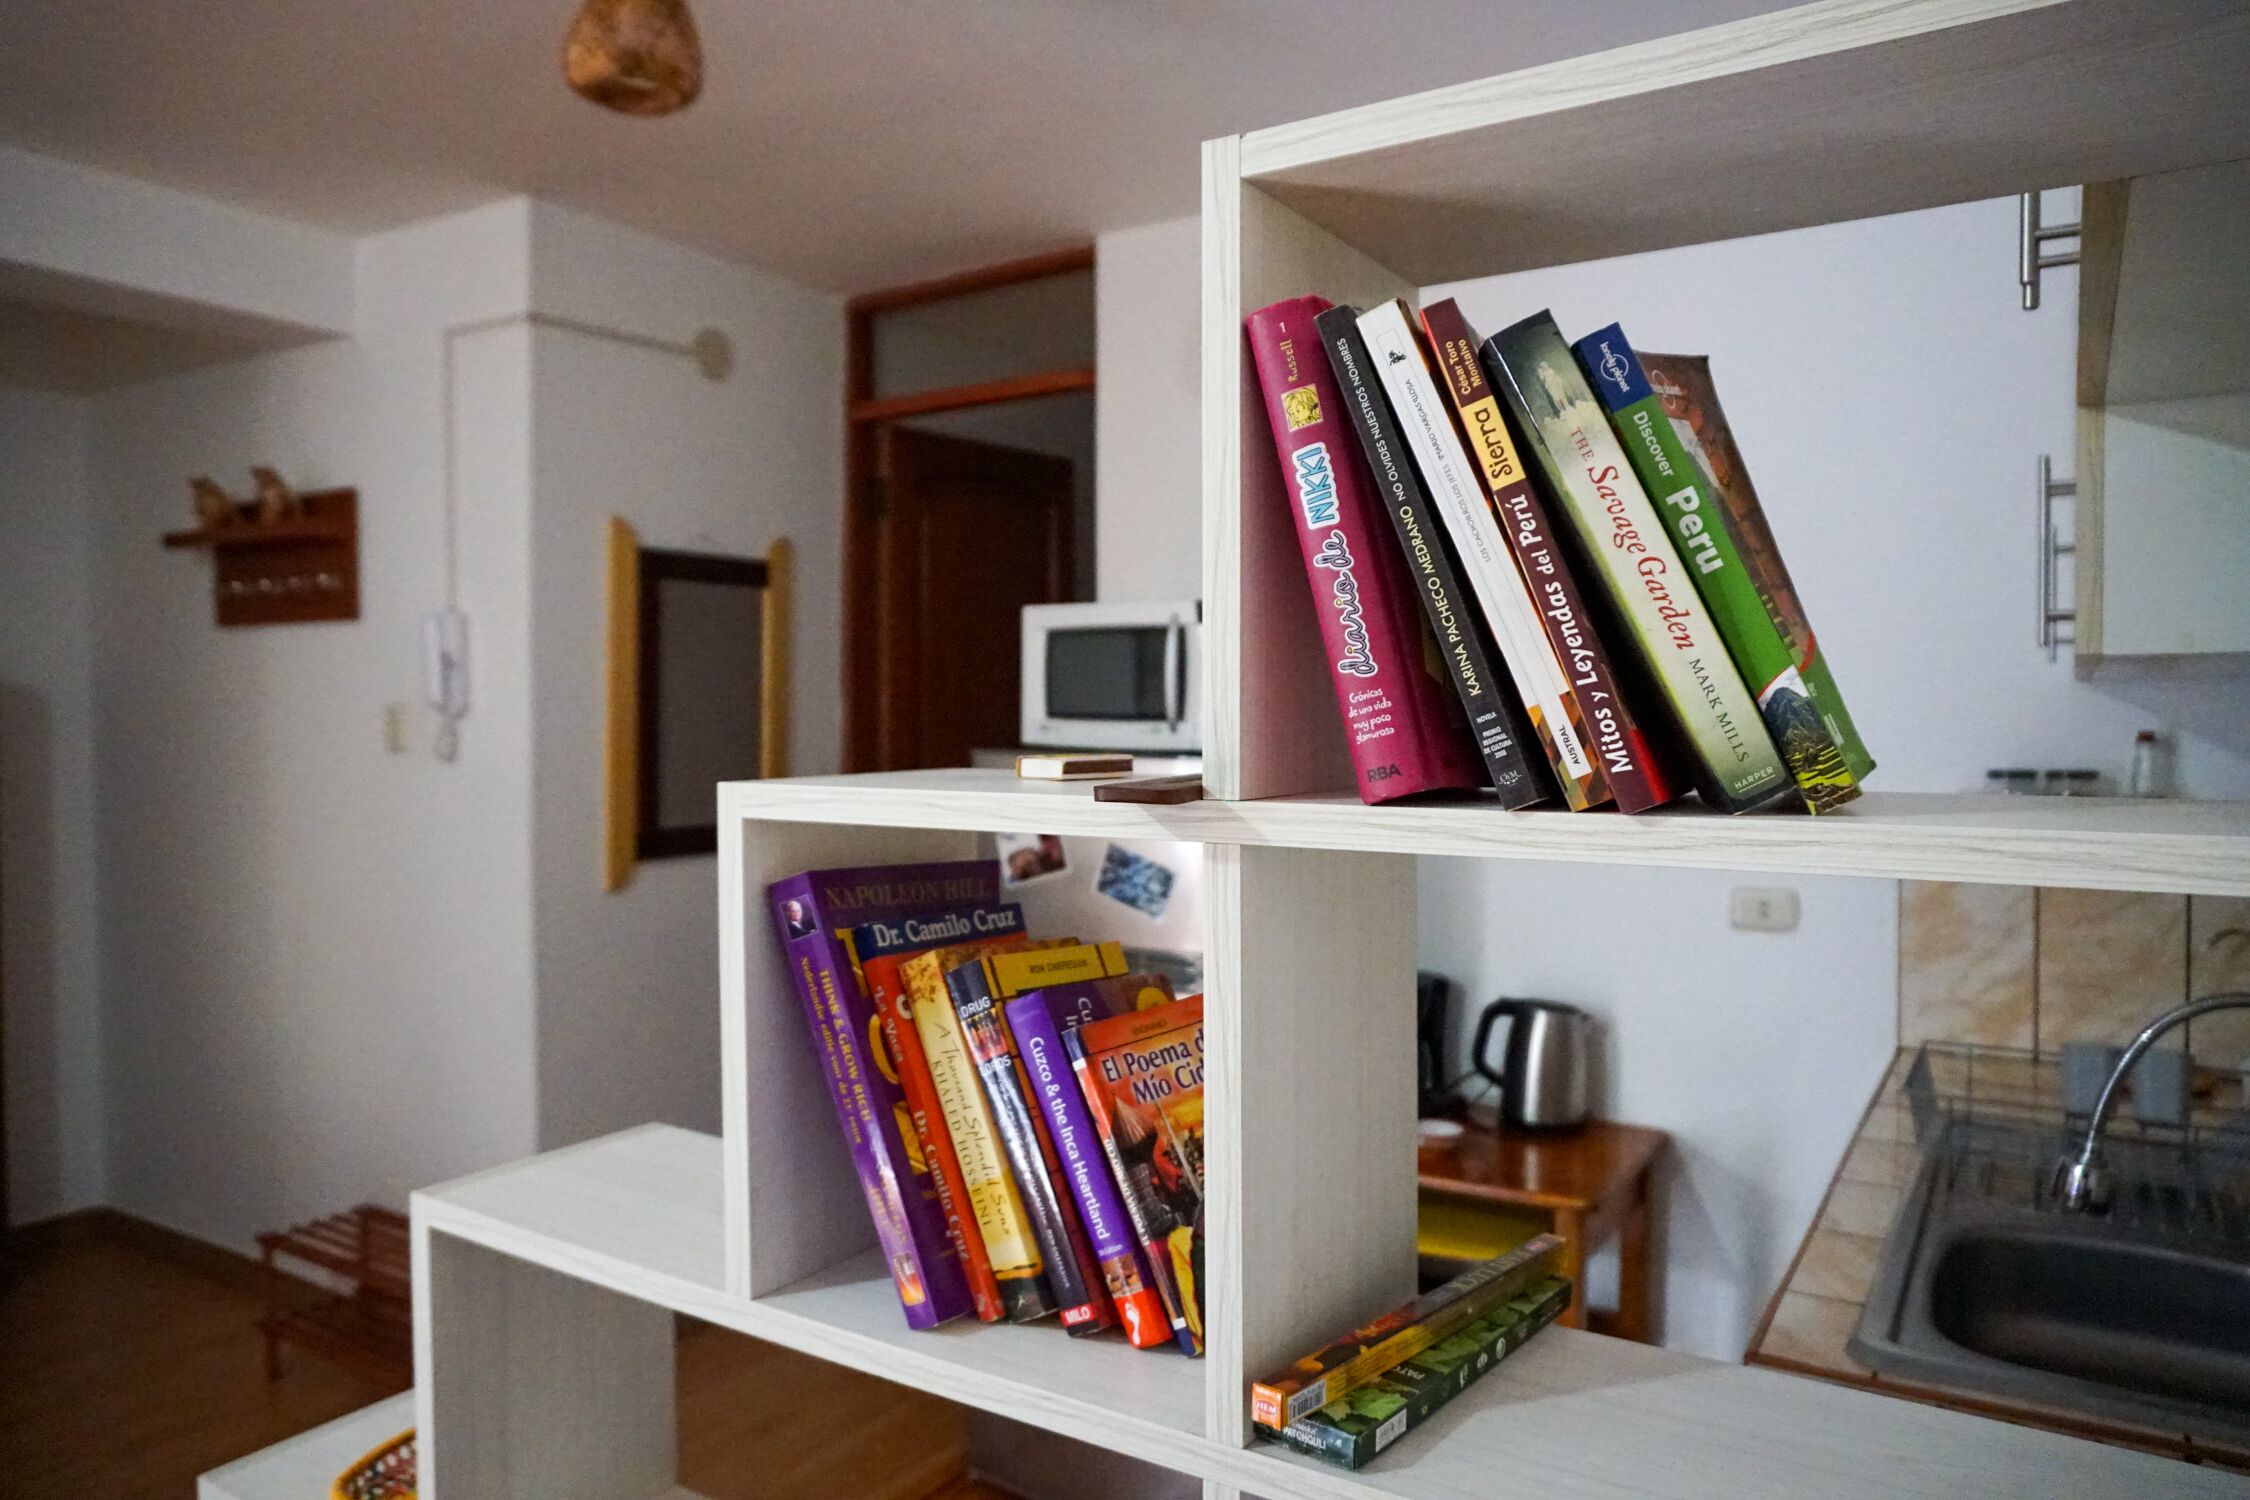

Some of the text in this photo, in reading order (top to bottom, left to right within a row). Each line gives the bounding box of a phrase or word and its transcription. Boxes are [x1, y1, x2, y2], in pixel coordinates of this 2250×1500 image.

[1280, 338, 1298, 384] Russell
[1445, 340, 1472, 395] César Toro
[1458, 339, 1483, 388] Montalvo
[1600, 341, 1630, 394] lonely planet
[1336, 337, 1407, 502] NO OLVIDES NUESTROS NOMBRES
[1414, 402, 1433, 434] VARGAS
[1473, 407, 1513, 480] Sierra
[1632, 410, 1675, 478] Discover
[1665, 485, 1725, 576] Peru
[1295, 444, 1377, 677] diario de NIKKI
[1569, 425, 1695, 651] THE Savage Garden
[1400, 505, 1483, 697] KARINA PACHECO MEDRANO
[1504, 494, 1634, 775] Mitos y Leyendas del Perú
[1348, 688, 1383, 704] Crónicas
[1348, 696, 1392, 718] de una vida
[1476, 711, 1498, 724] NOVELA
[1688, 658, 1750, 763] MARK MILLS
[1353, 713, 1392, 731] muy poco
[1355, 726, 1395, 745] glamurosa
[1558, 724, 1580, 766] AUSTRAL
[1367, 763, 1402, 782] RBA
[1733, 766, 1775, 790] HARPER
[824, 877, 988, 909] NAPOLEON HILL
[872, 908, 1017, 947] Dr. Camilo Cruz
[873, 985, 888, 1013] La
[886, 1017, 904, 1063] Vaca
[960, 995, 991, 1019] DRUG
[819, 968, 872, 1121] THINK & GROW RICH
[1029, 1036, 1052, 1081] Cuzco
[1101, 1055, 1123, 1083] El
[1122, 1041, 1192, 1076] Poema
[1045, 1083, 1060, 1098] &
[1132, 1057, 1204, 1105] Mío Cid
[934, 1021, 1011, 1236] A Thousand Splendid Suns
[1051, 1097, 1067, 1126] the
[931, 1059, 992, 1226] KHALED HOSSEINI
[1060, 1125, 1079, 1160] Inca
[913, 1109, 970, 1261] Dr. Camilo Cruz
[1072, 1160, 1111, 1241] Heartland
[1122, 1196, 1147, 1234] POEMA
